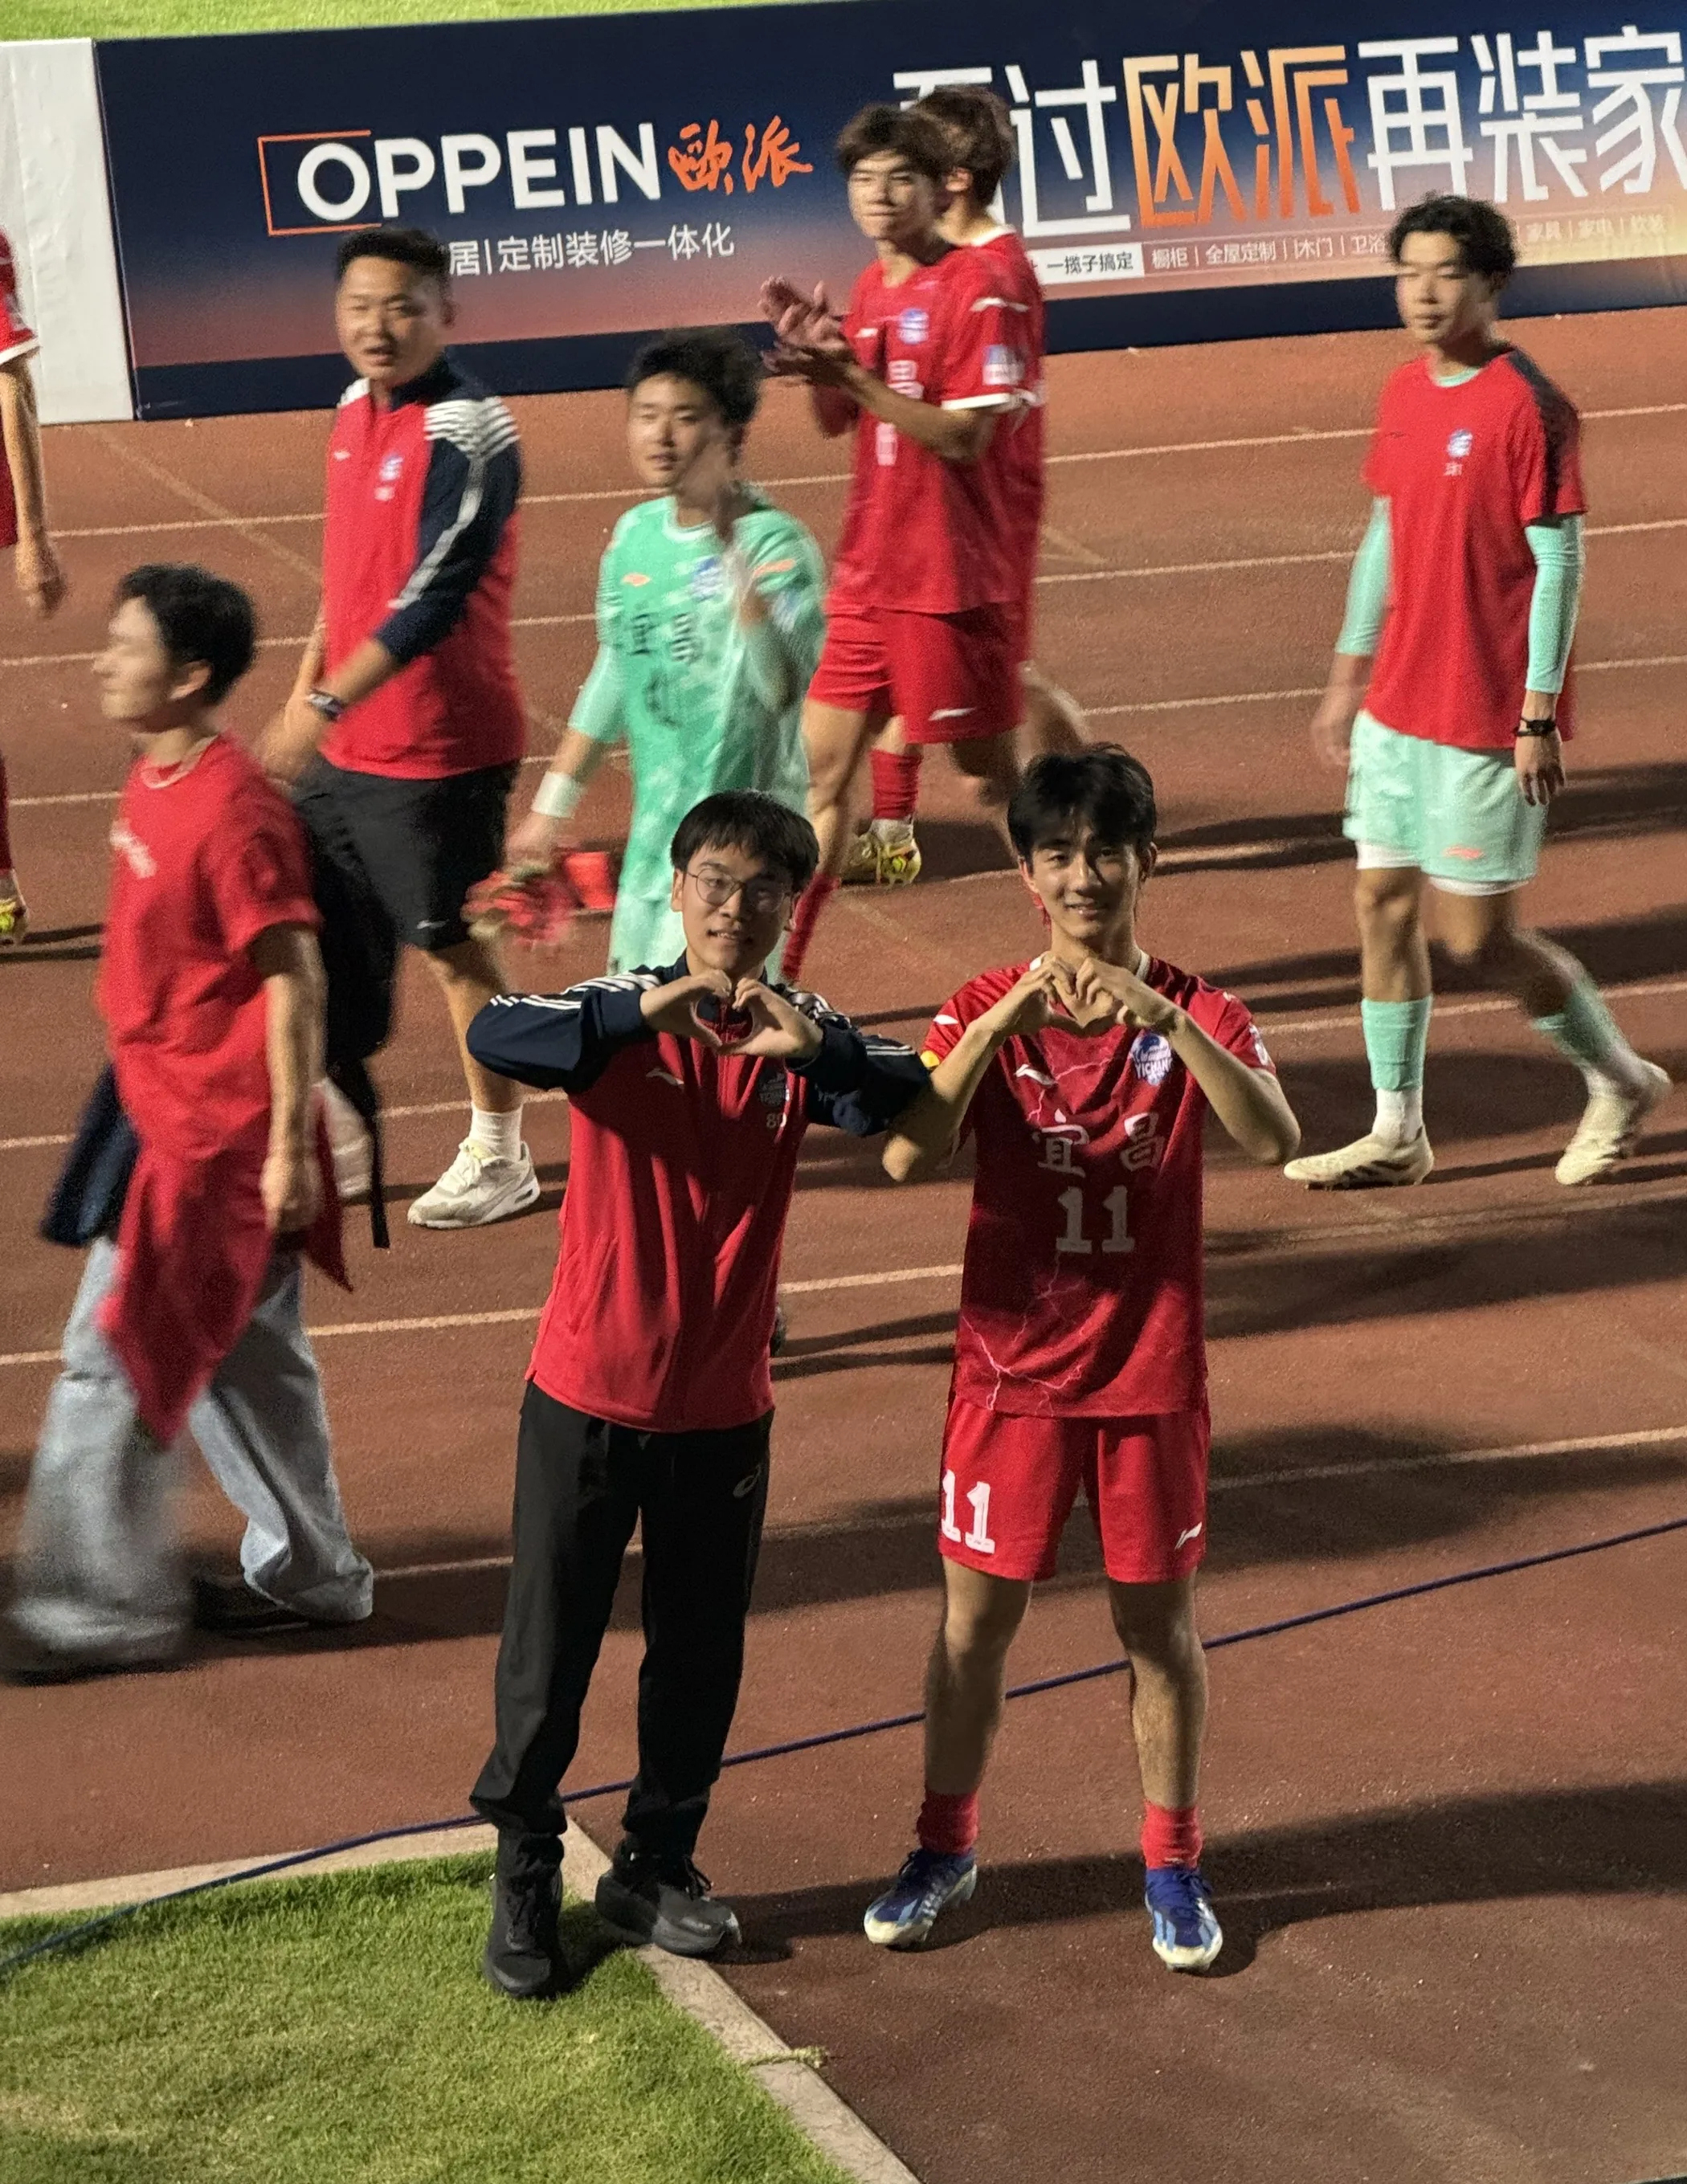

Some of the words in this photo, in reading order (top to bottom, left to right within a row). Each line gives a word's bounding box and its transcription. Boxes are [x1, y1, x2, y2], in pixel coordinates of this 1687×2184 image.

[297, 122, 661, 222] OPPEIN
[1031, 251, 1134, 275] 一揽子搞定
[1031, 1108, 1166, 1178] 宜昌
[1056, 1185, 1136, 1254] 11
[942, 1469, 995, 1554] 11
